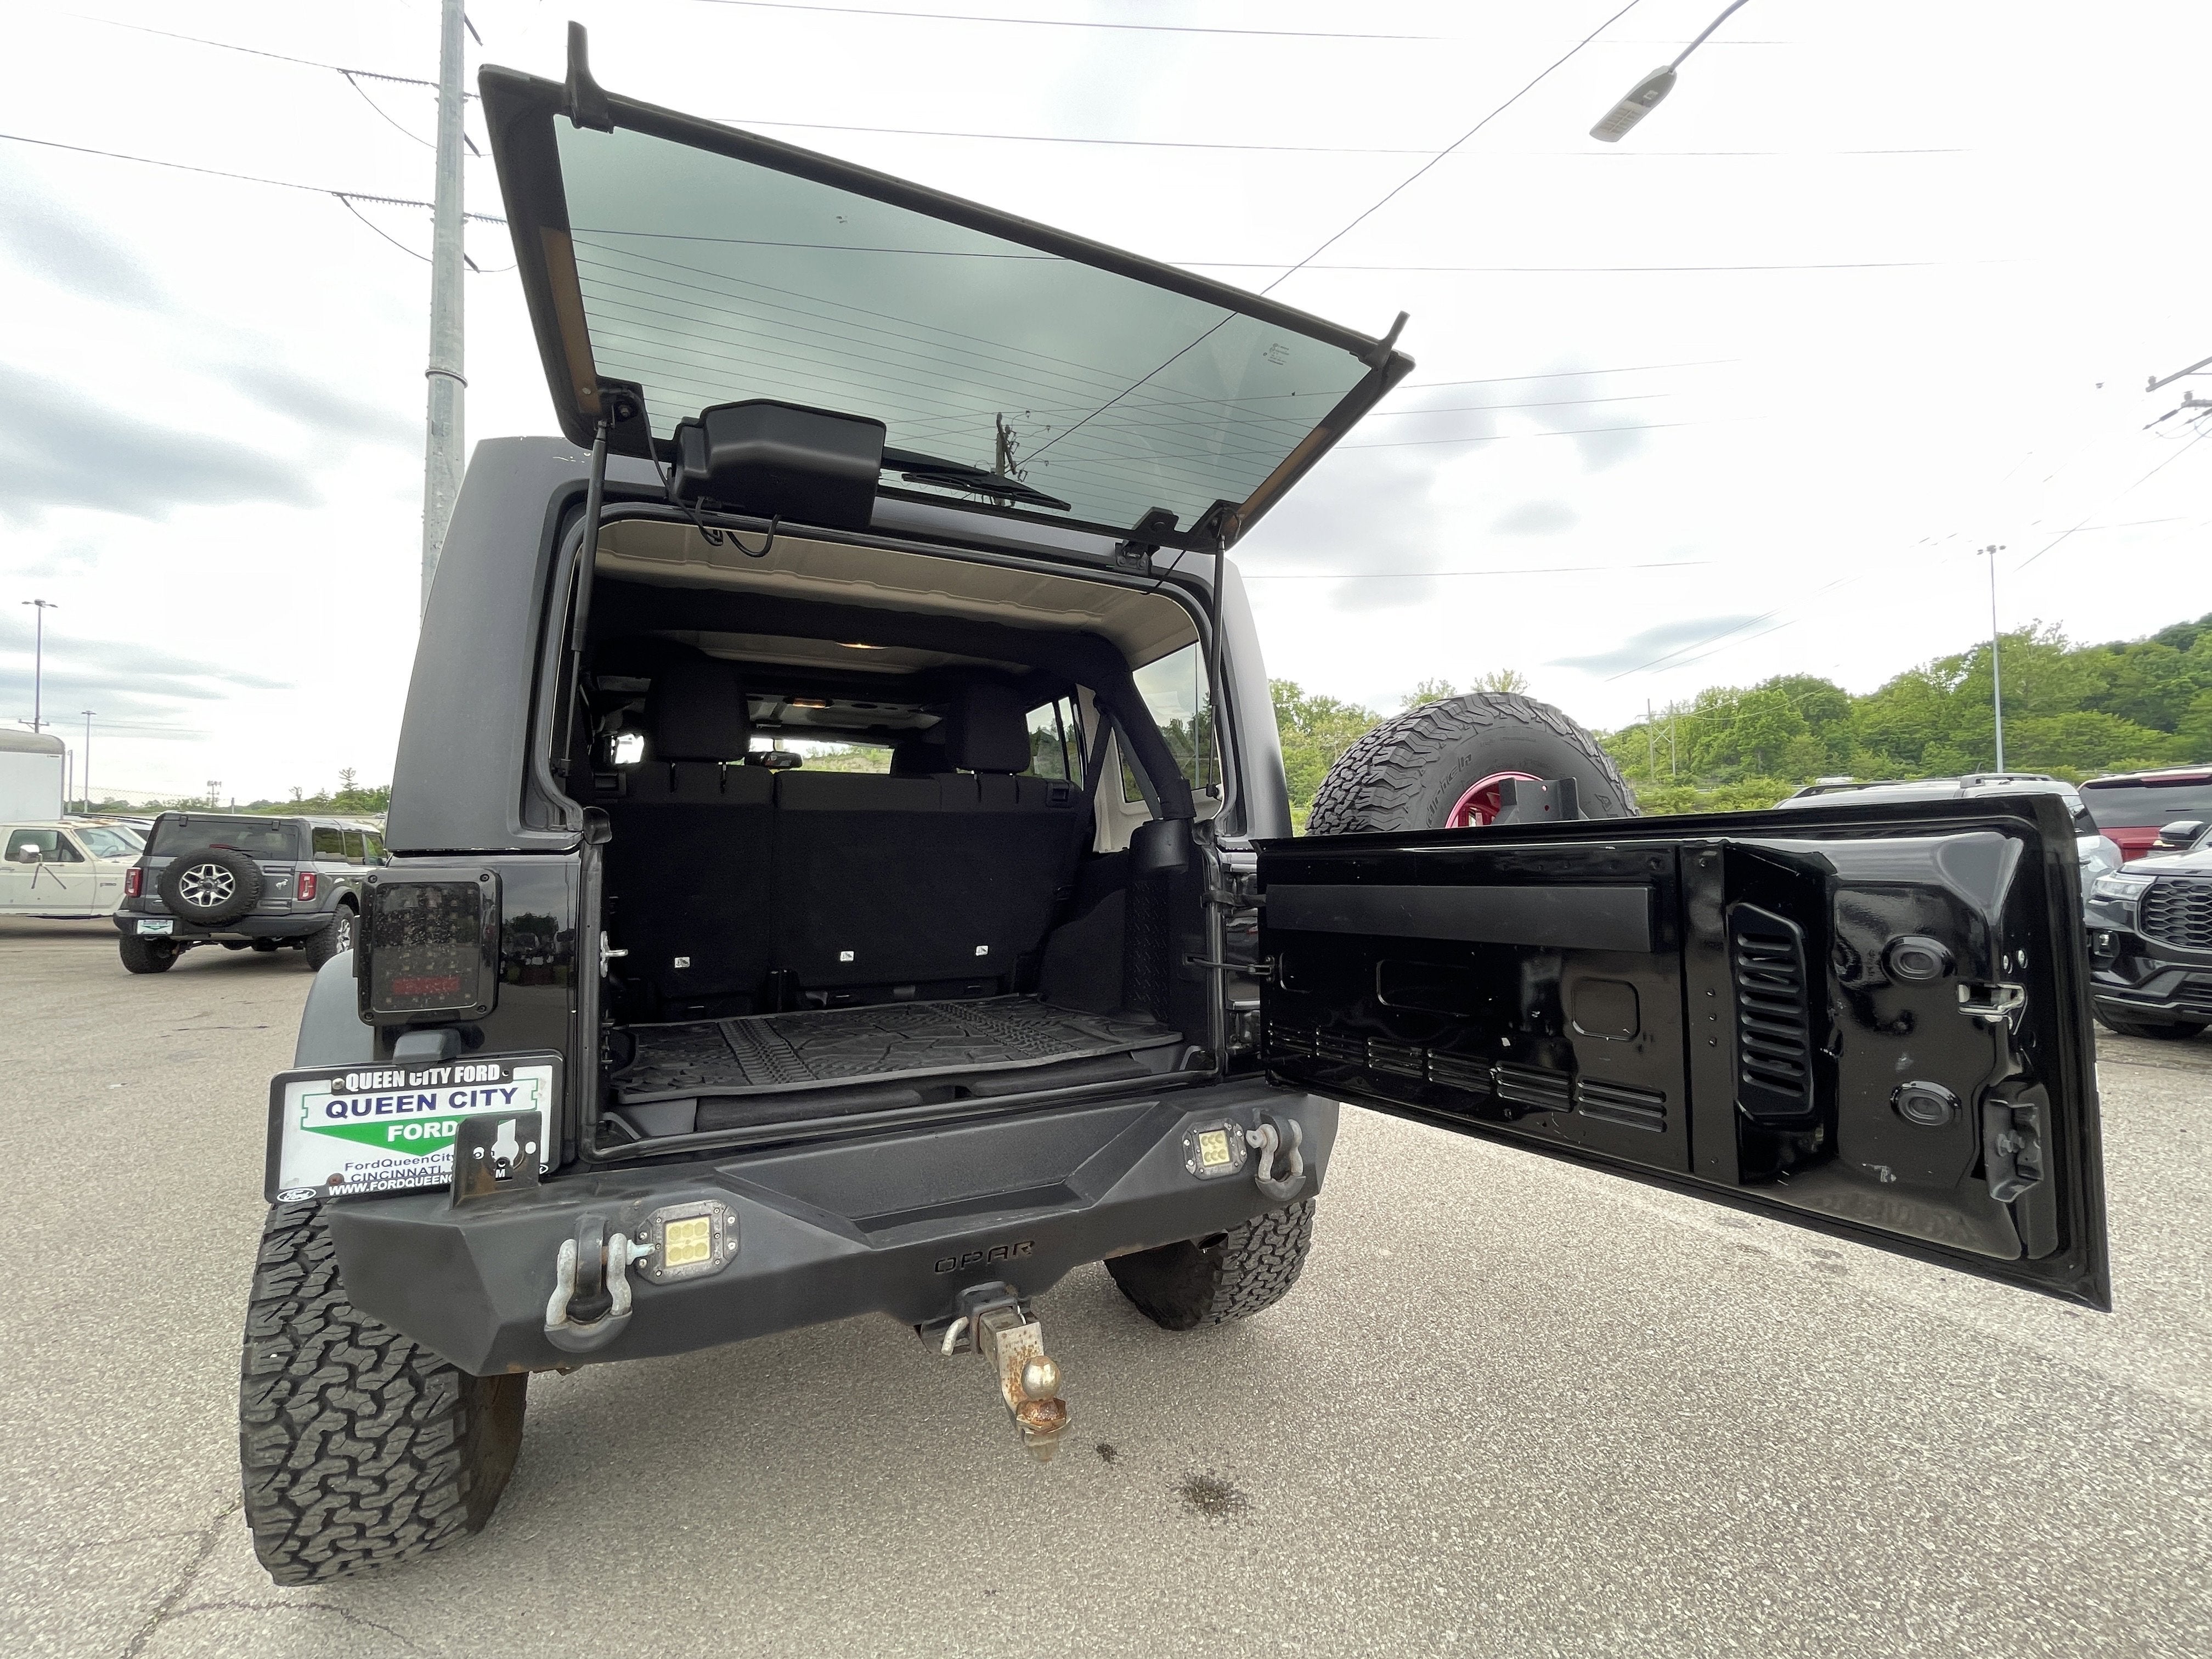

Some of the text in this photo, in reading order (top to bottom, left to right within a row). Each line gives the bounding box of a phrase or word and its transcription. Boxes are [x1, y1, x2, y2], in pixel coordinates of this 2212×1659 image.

[346, 1064, 500, 1092] QUEEN CITY FORD
[326, 1087, 518, 1119] QUEEN CITY
[387, 1121, 458, 1142] FORD
